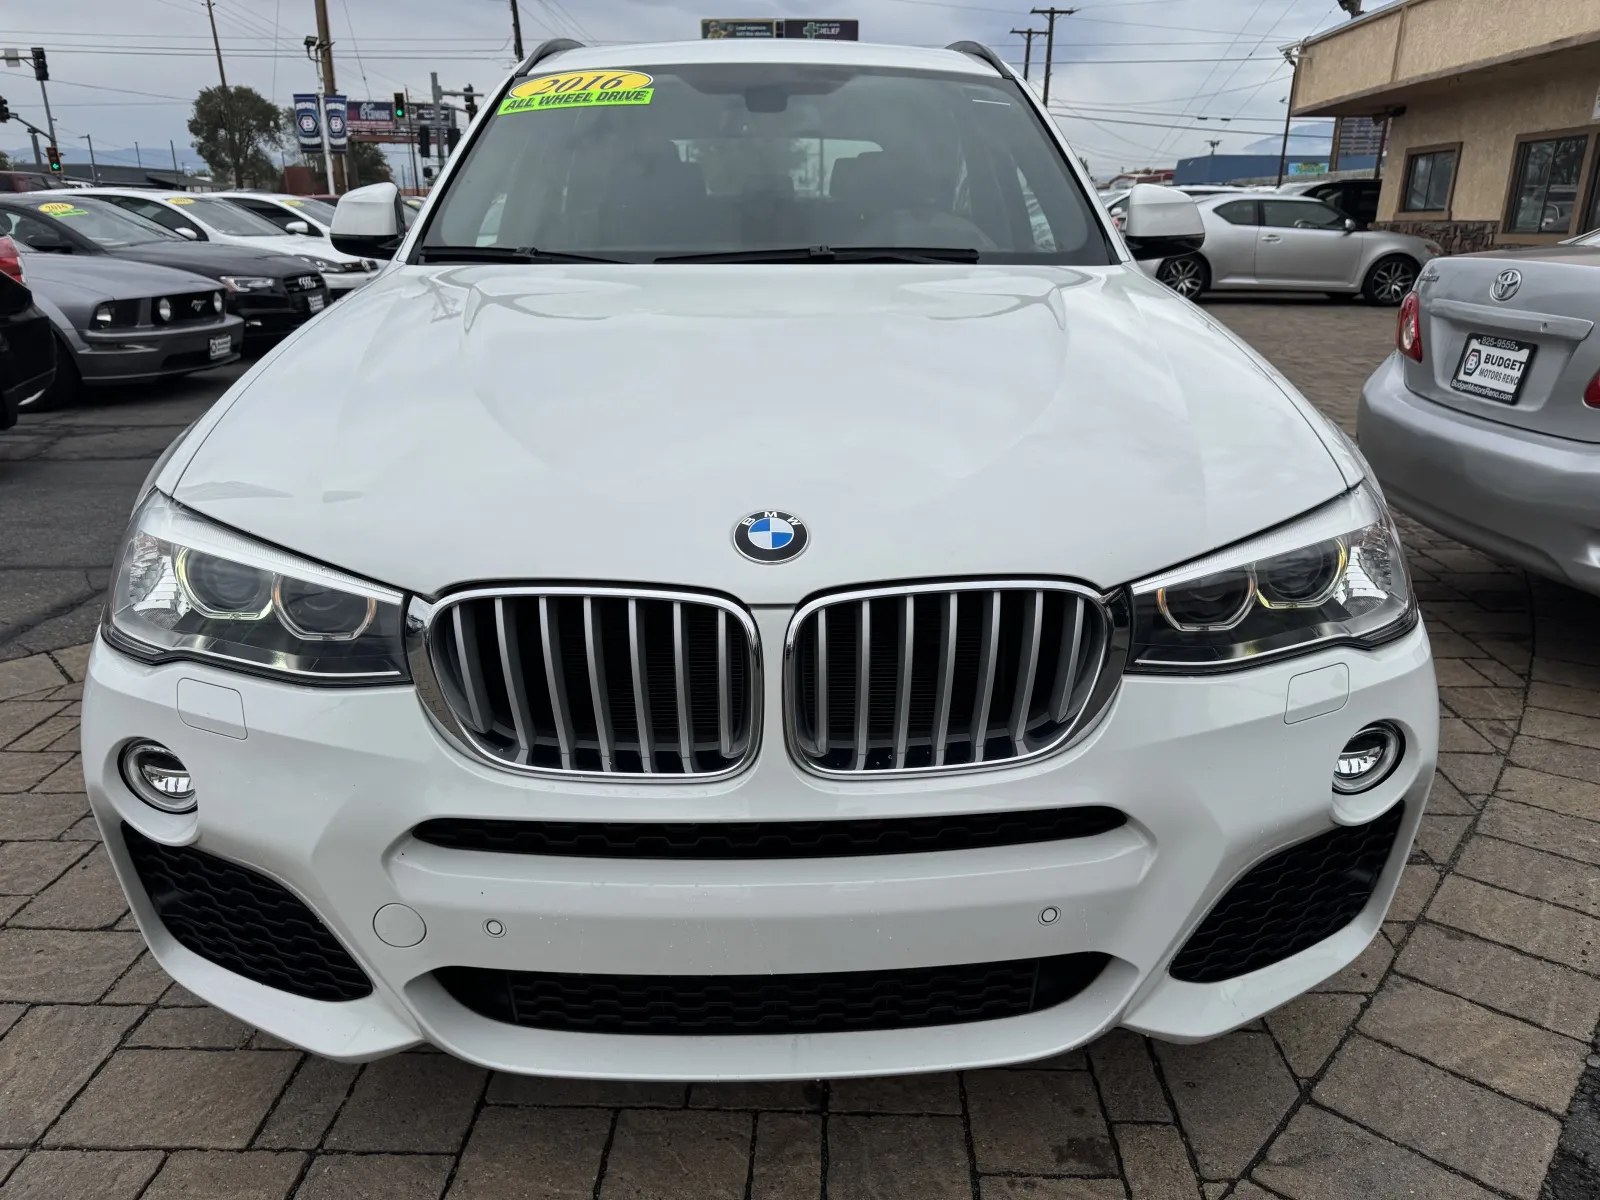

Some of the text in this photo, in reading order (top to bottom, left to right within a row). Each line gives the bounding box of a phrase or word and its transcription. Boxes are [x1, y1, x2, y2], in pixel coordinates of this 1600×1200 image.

[529, 74, 632, 96] 2016
[504, 90, 650, 112] ALL WHEEL DRIVE
[1481, 336, 1516, 351] 825-9555
[1483, 353, 1526, 372] BUDGET
[1479, 367, 1502, 382] MOTORS
[1451, 379, 1513, 401] BudgetMotorsReno.com
[741, 511, 802, 527] BMW
